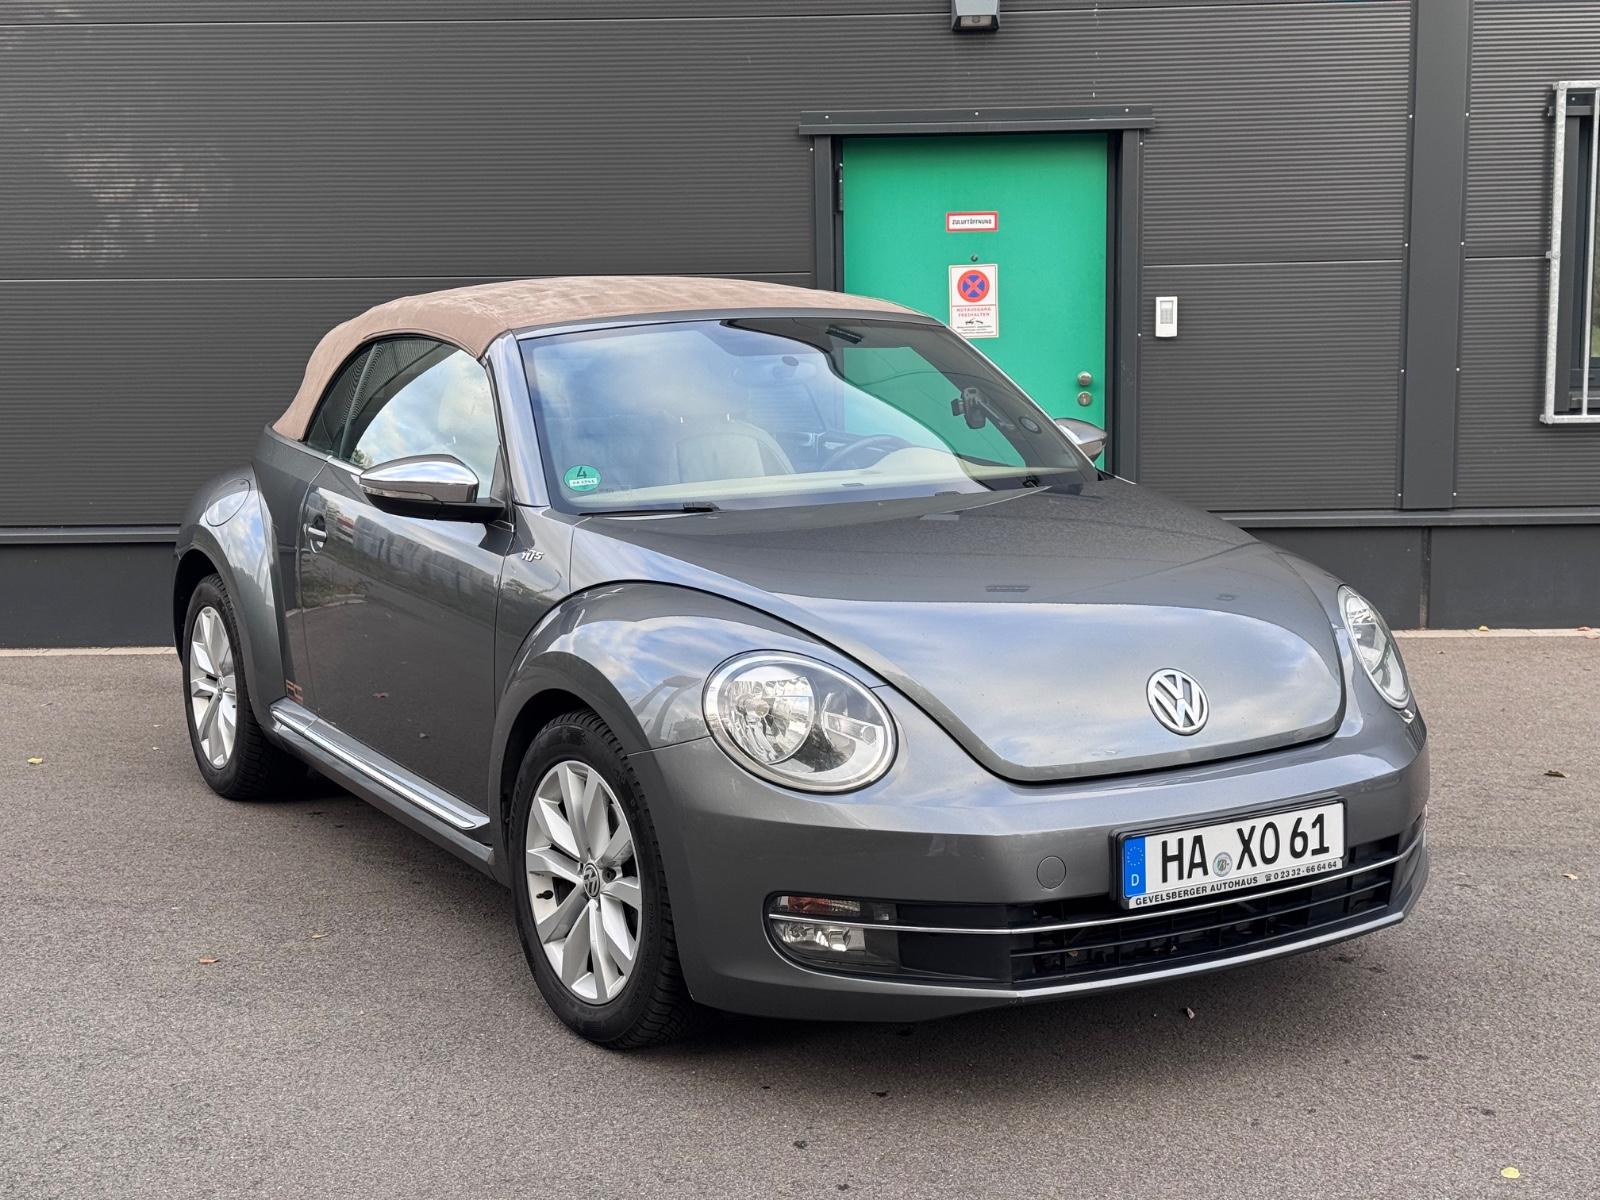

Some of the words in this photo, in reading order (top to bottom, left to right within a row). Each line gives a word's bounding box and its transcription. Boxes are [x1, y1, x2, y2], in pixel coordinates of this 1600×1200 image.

[577, 466, 587, 478] 4
[1147, 669, 1208, 735] VW
[1161, 834, 1209, 884] HA
[1236, 821, 1280, 871] XO
[1289, 813, 1330, 860] 61
[1131, 873, 1140, 887] D
[1135, 886, 1208, 906] GEVELSBERGER
[1210, 876, 1258, 892] AUTOHAUS
